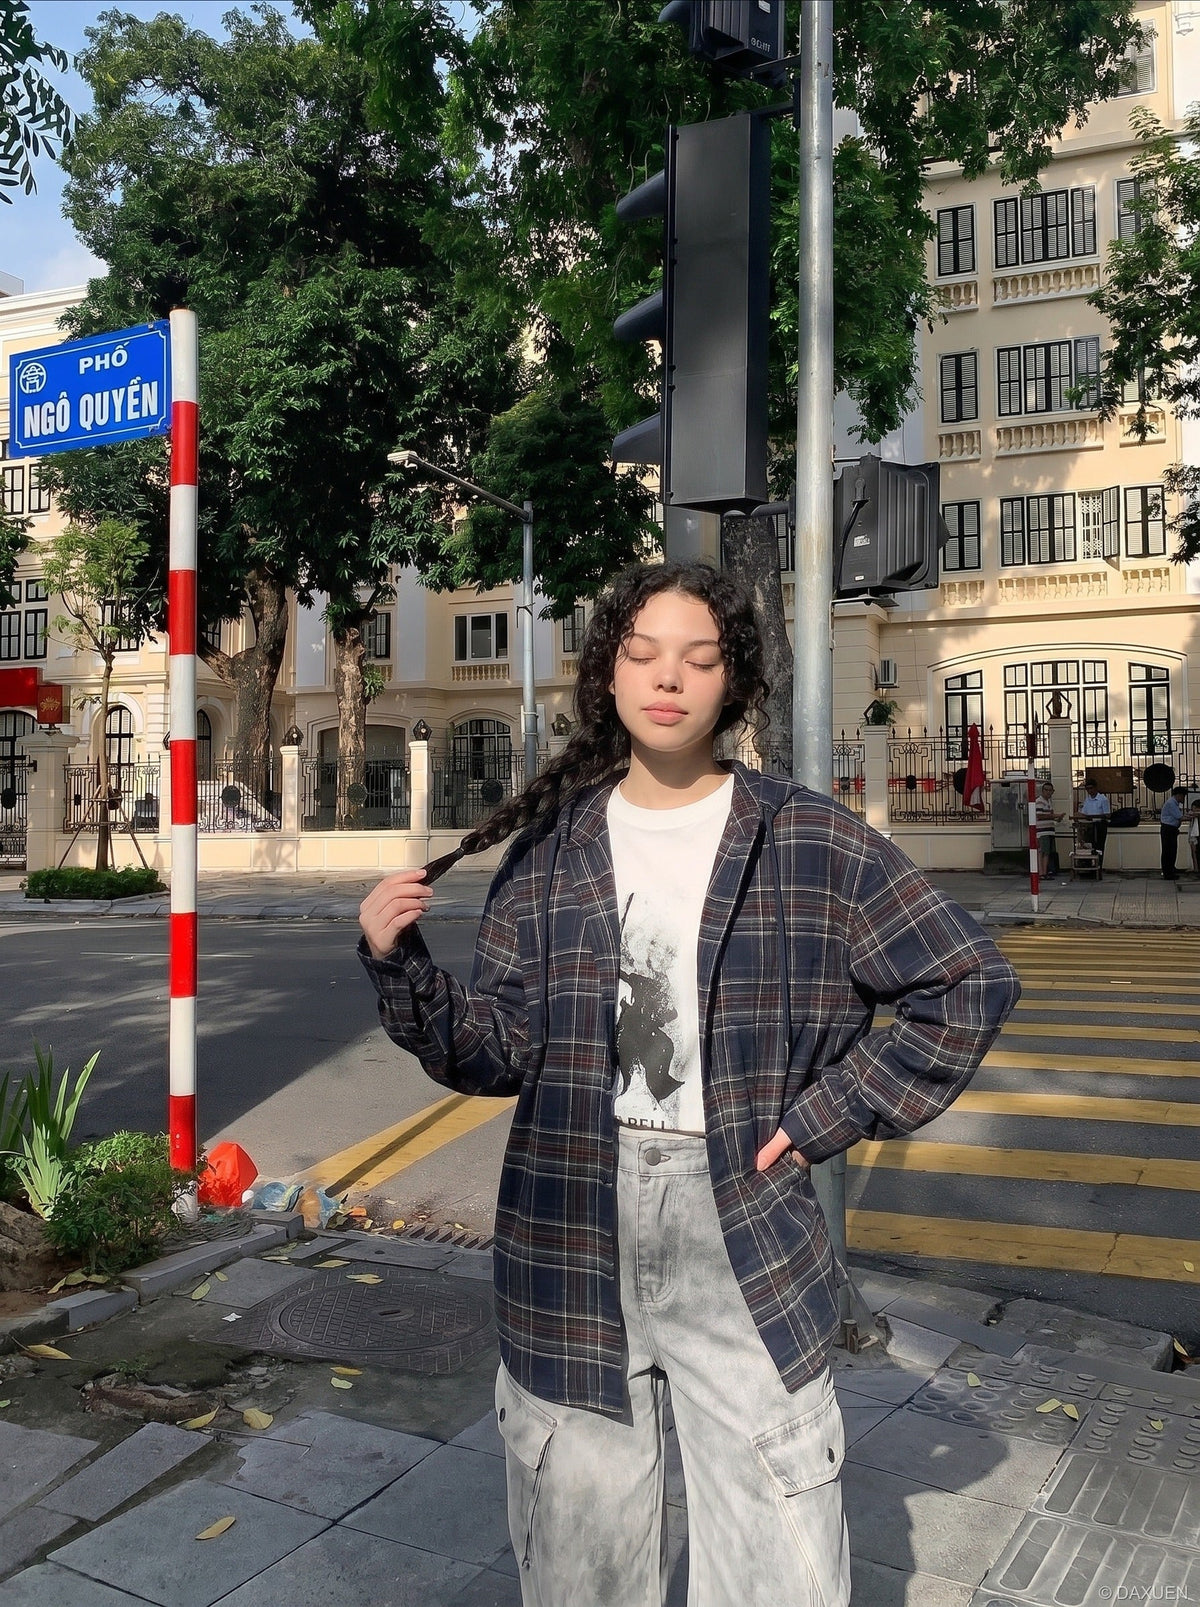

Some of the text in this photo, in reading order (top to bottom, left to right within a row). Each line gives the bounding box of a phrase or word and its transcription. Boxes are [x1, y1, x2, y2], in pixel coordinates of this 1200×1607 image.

[79, 341, 130, 375] PHỐ
[24, 376, 159, 439] NGÔ QUYỀN
